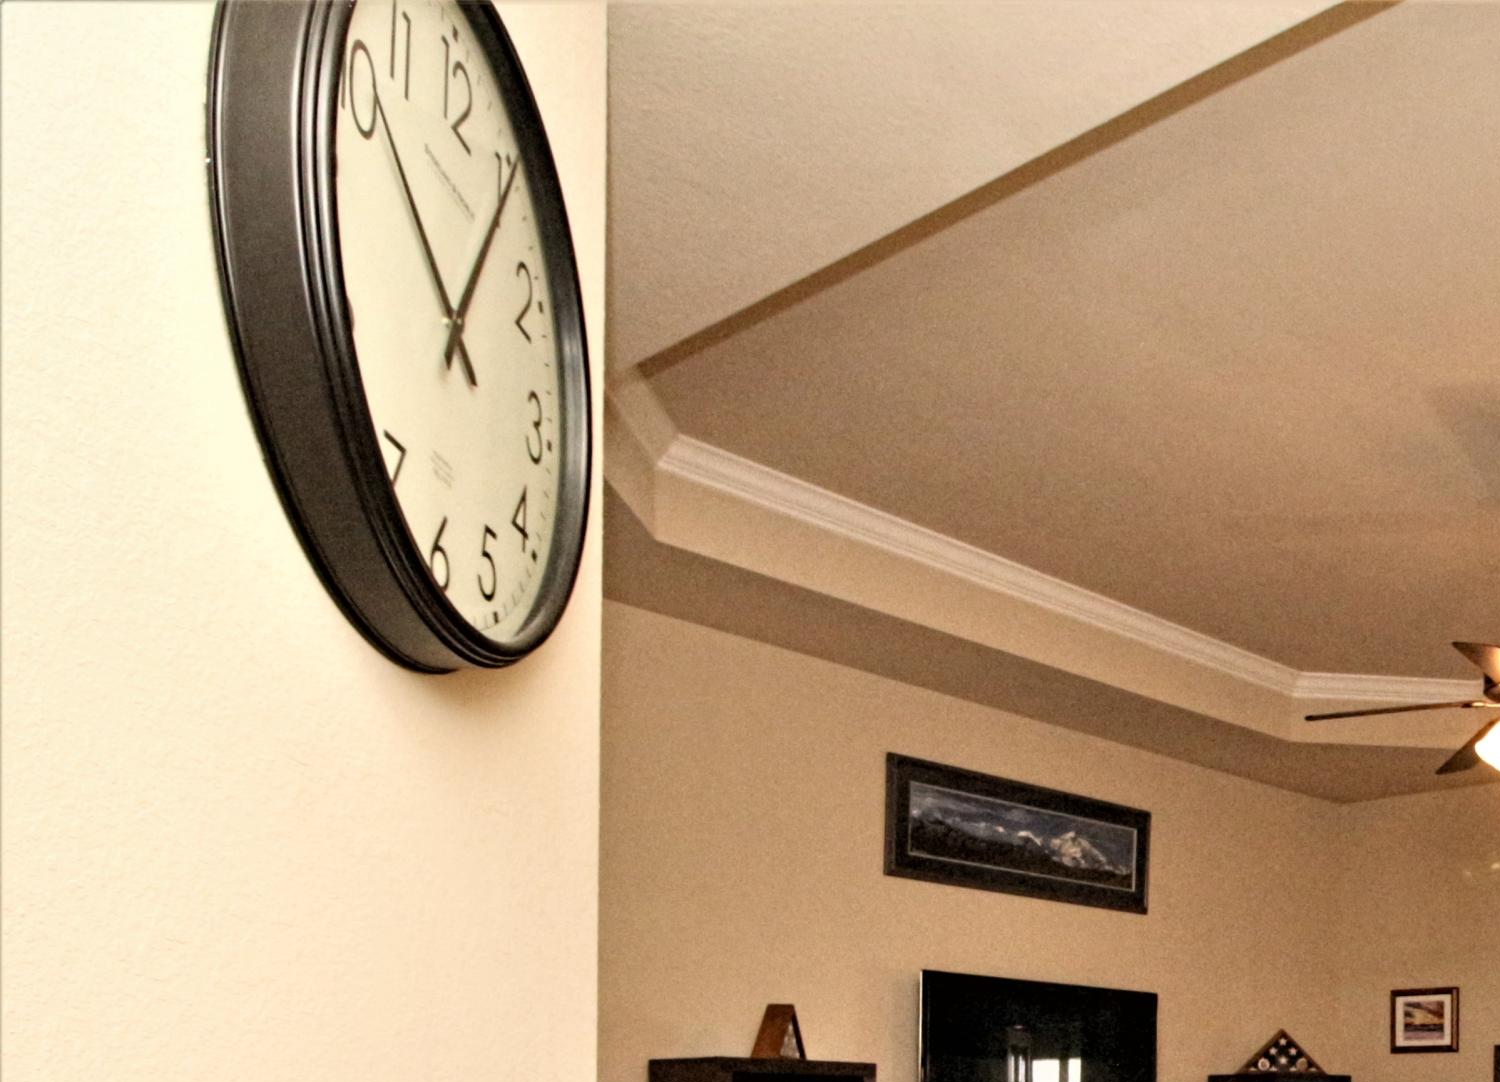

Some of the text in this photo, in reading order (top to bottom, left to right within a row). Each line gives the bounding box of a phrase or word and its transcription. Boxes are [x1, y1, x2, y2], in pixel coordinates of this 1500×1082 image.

[441, 34, 472, 157] 12
[495, 151, 502, 229] 1
[515, 261, 534, 344] 2
[383, 428, 407, 489] 7
[526, 390, 543, 465] 3
[430, 516, 450, 594] 6
[511, 485, 529, 553] 4
[477, 524, 498, 602] 5
